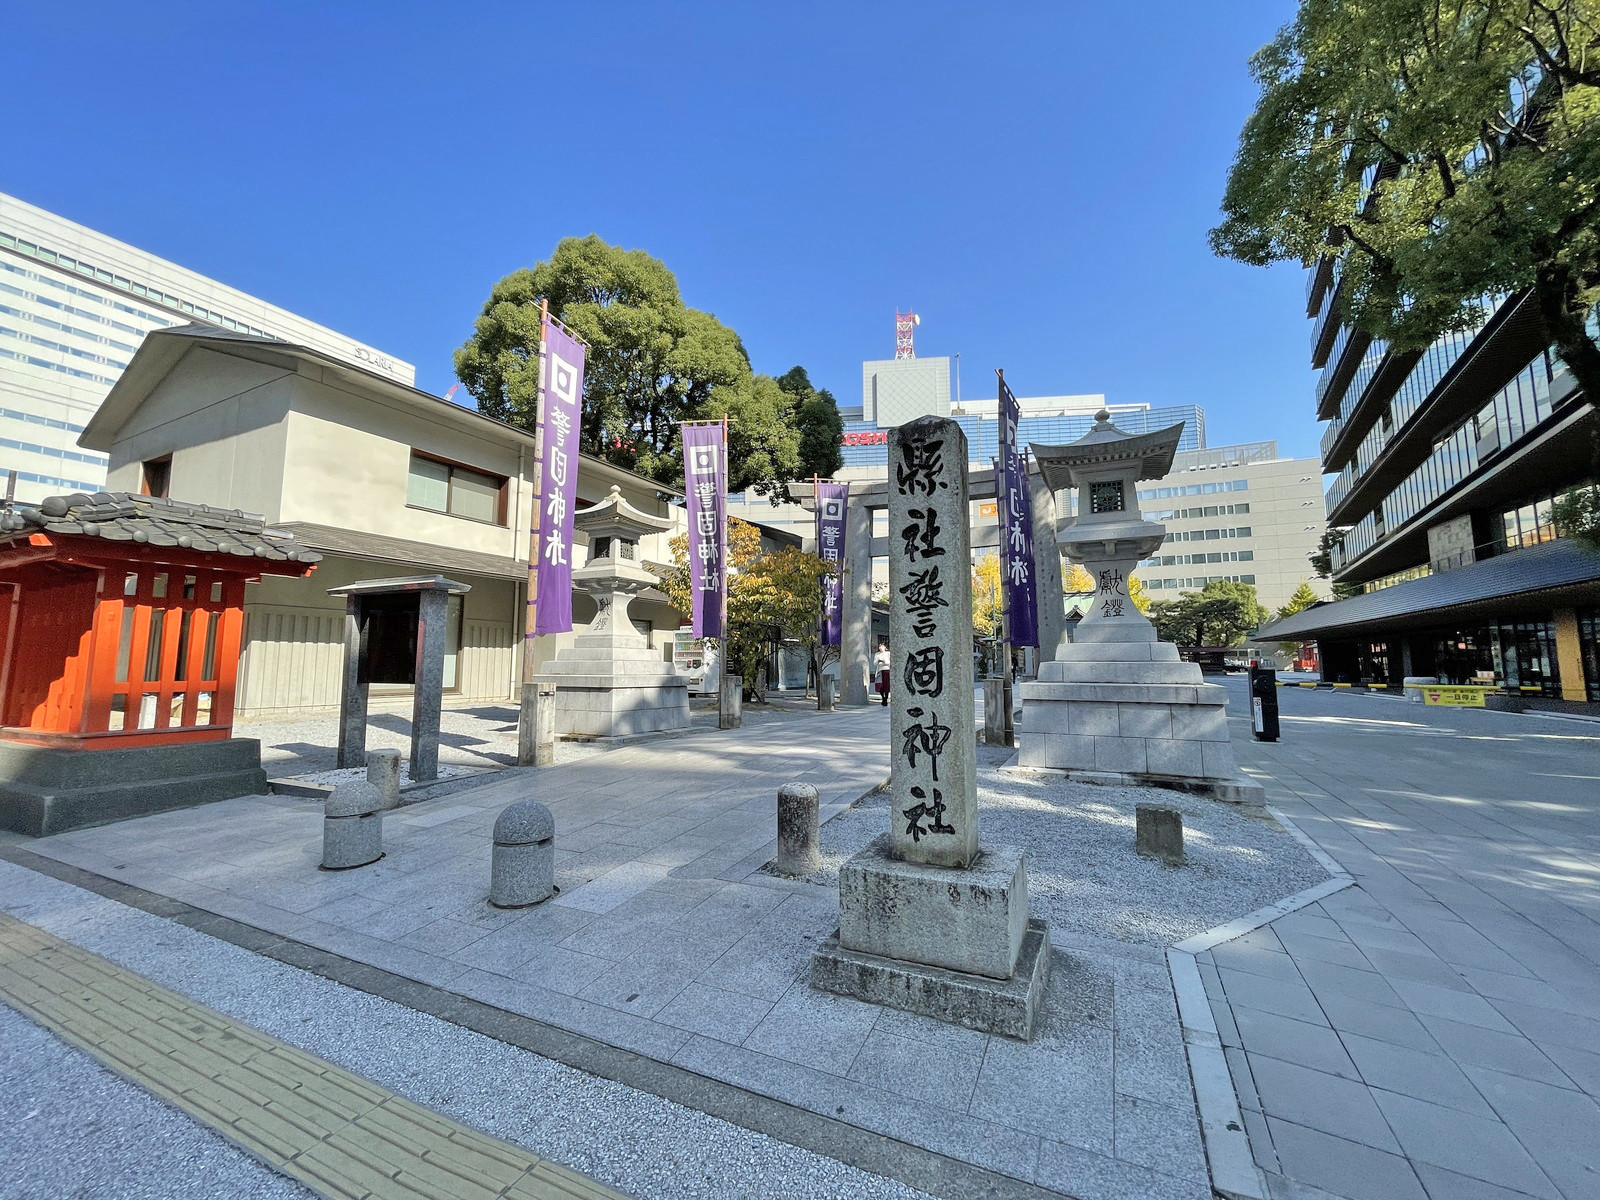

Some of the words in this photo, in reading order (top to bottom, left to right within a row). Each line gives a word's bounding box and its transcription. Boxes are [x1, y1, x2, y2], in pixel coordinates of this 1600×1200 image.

[354, 347, 393, 373] SOLARIA
[544, 405, 572, 567] 警固神社
